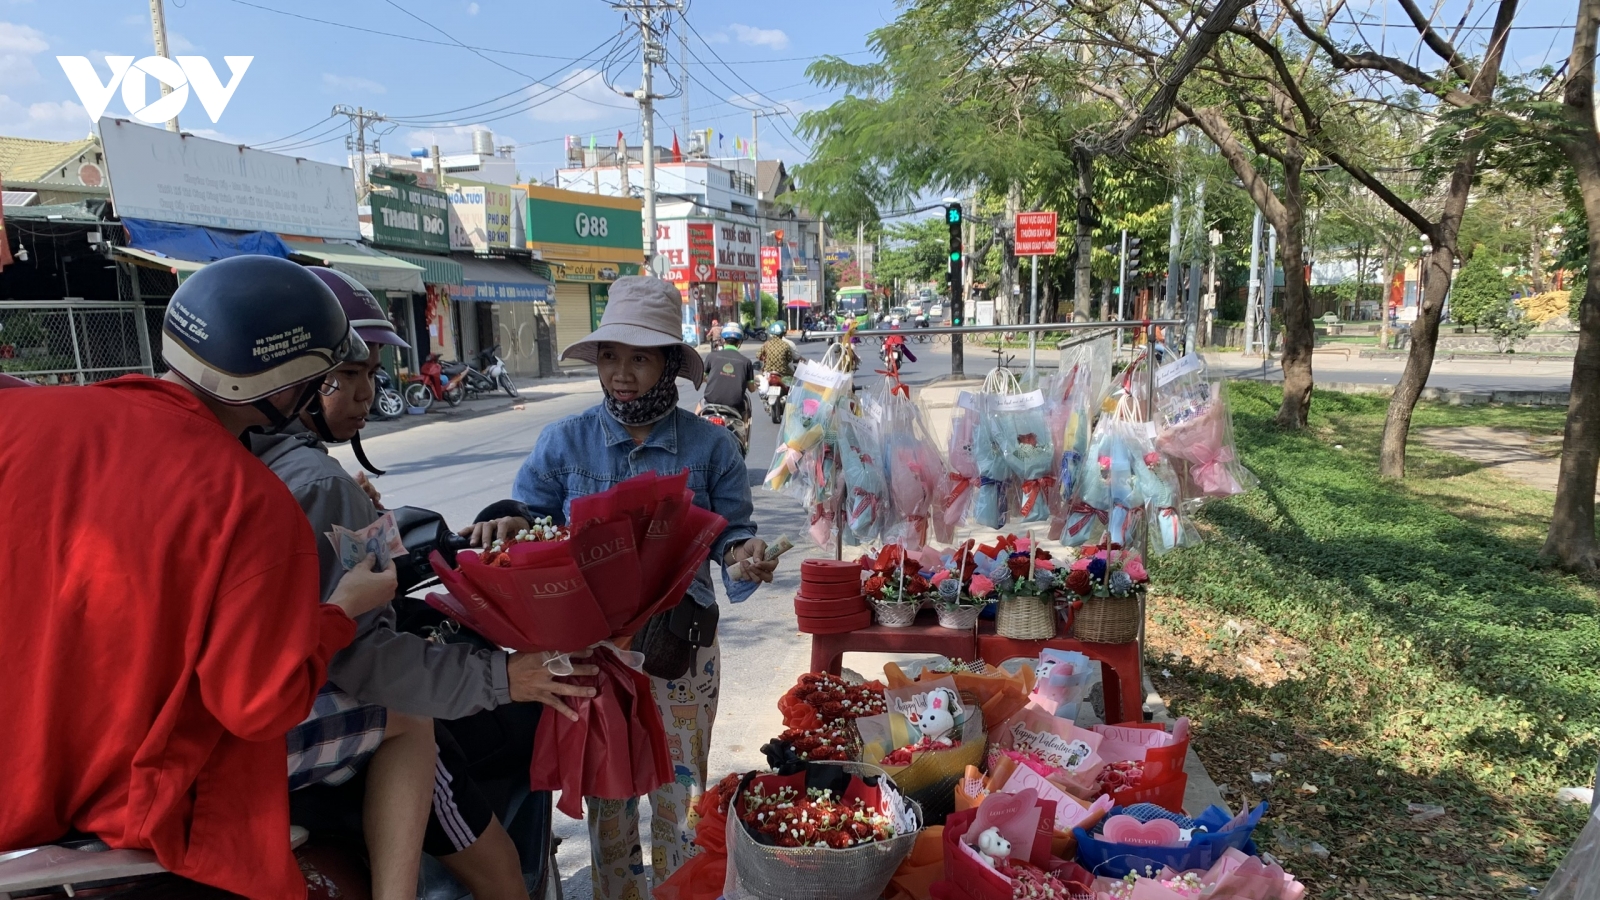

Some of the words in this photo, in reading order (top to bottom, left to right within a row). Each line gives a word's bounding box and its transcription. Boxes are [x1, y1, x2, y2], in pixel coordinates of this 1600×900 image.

[498, 193, 508, 207] 81
[575, 212, 608, 238] F88
[1019, 216, 1028, 224] KHU
[1037, 215, 1046, 224] GIAO
[1045, 229, 1051, 237] RA
[1032, 241, 1041, 250] GIAO
[718, 241, 735, 265] MẮT
[737, 246, 756, 267] KÍNH
[265, 333, 284, 343] Thống
[252, 339, 290, 357] Hoàng
[580, 537, 627, 565] LOVE
[531, 578, 582, 595] LOVE
[897, 699, 917, 715] happy
[1012, 723, 1037, 744] happy
[1037, 734, 1077, 754] Valentine
[1095, 727, 1135, 742] LOVE
[1013, 766, 1053, 798] LOVE
